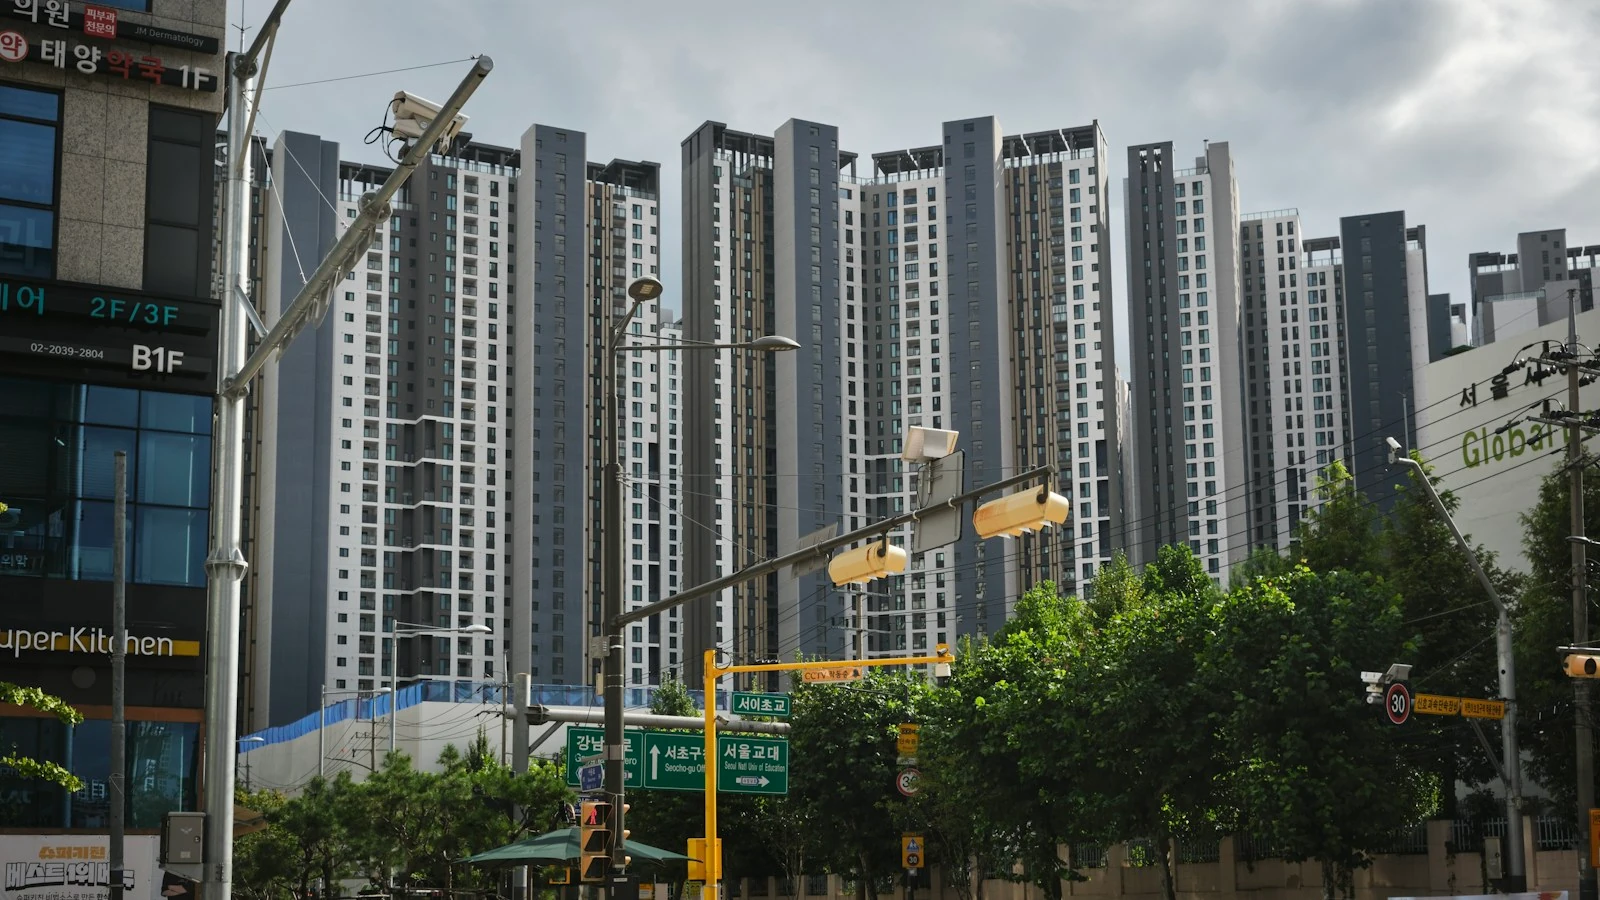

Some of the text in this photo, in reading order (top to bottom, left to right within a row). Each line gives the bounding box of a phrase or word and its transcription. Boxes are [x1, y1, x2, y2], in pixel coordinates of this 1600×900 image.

[13, 0, 69, 29] 의원
[86, 8, 115, 23] 피부과
[86, 20, 115, 36] 전문의
[135, 26, 204, 48] JM Dermatology
[0, 34, 23, 57] 약
[179, 65, 210, 91] 1F
[90, 297, 179, 326] 2F/3F
[30, 342, 104, 360] 02-2039-2804
[132, 344, 185, 374] B1F
[1462, 423, 1553, 469] Global
[804, 671, 827, 680] CCTV
[738, 695, 786, 712] 서이초교
[1391, 694, 1405, 713] 30
[576, 735, 634, 752] 강남로
[724, 743, 779, 761] 서울교대
[664, 763, 696, 775] Seocho-gu
[724, 760, 737, 770] Seoul
[765, 763, 786, 772] Education
[39, 846, 106, 860] 슈퍼키친
[909, 856, 918, 864] 30
[5, 862, 65, 891] 베스트
